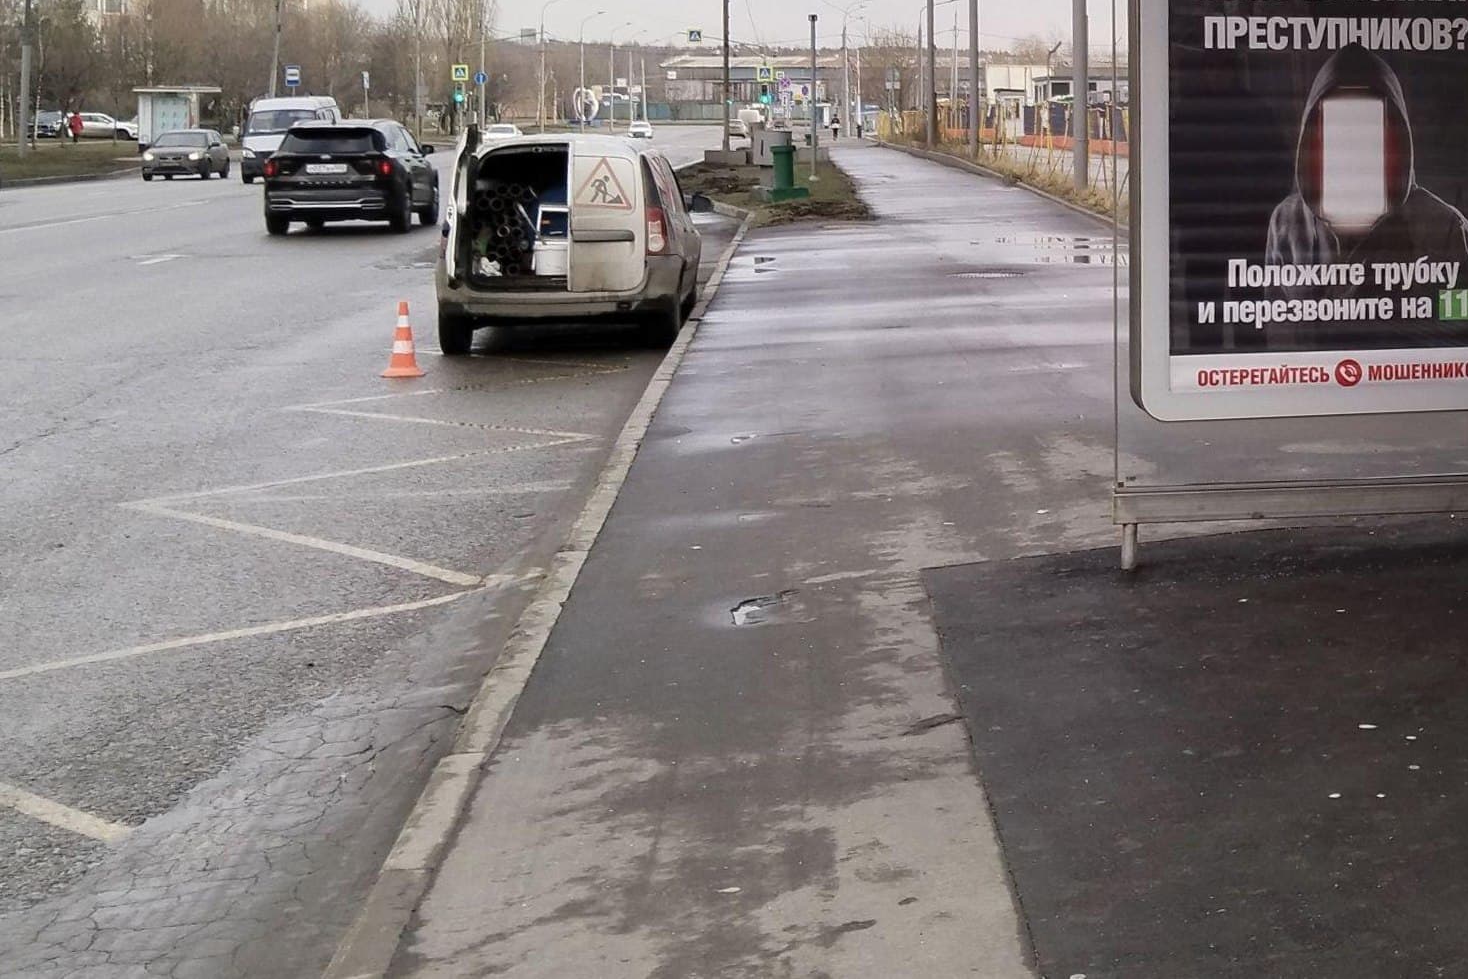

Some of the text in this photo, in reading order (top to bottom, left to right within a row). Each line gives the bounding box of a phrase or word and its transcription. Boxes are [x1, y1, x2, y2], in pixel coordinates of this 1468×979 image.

[1228, 255, 1460, 291] Положите трубку
[1198, 302, 1215, 323] и
[1223, 296, 1394, 329] перезвоните
[1401, 295, 1433, 319] на
[1198, 364, 1330, 387] ОСТЕРЕГАЙТЕСЬ
